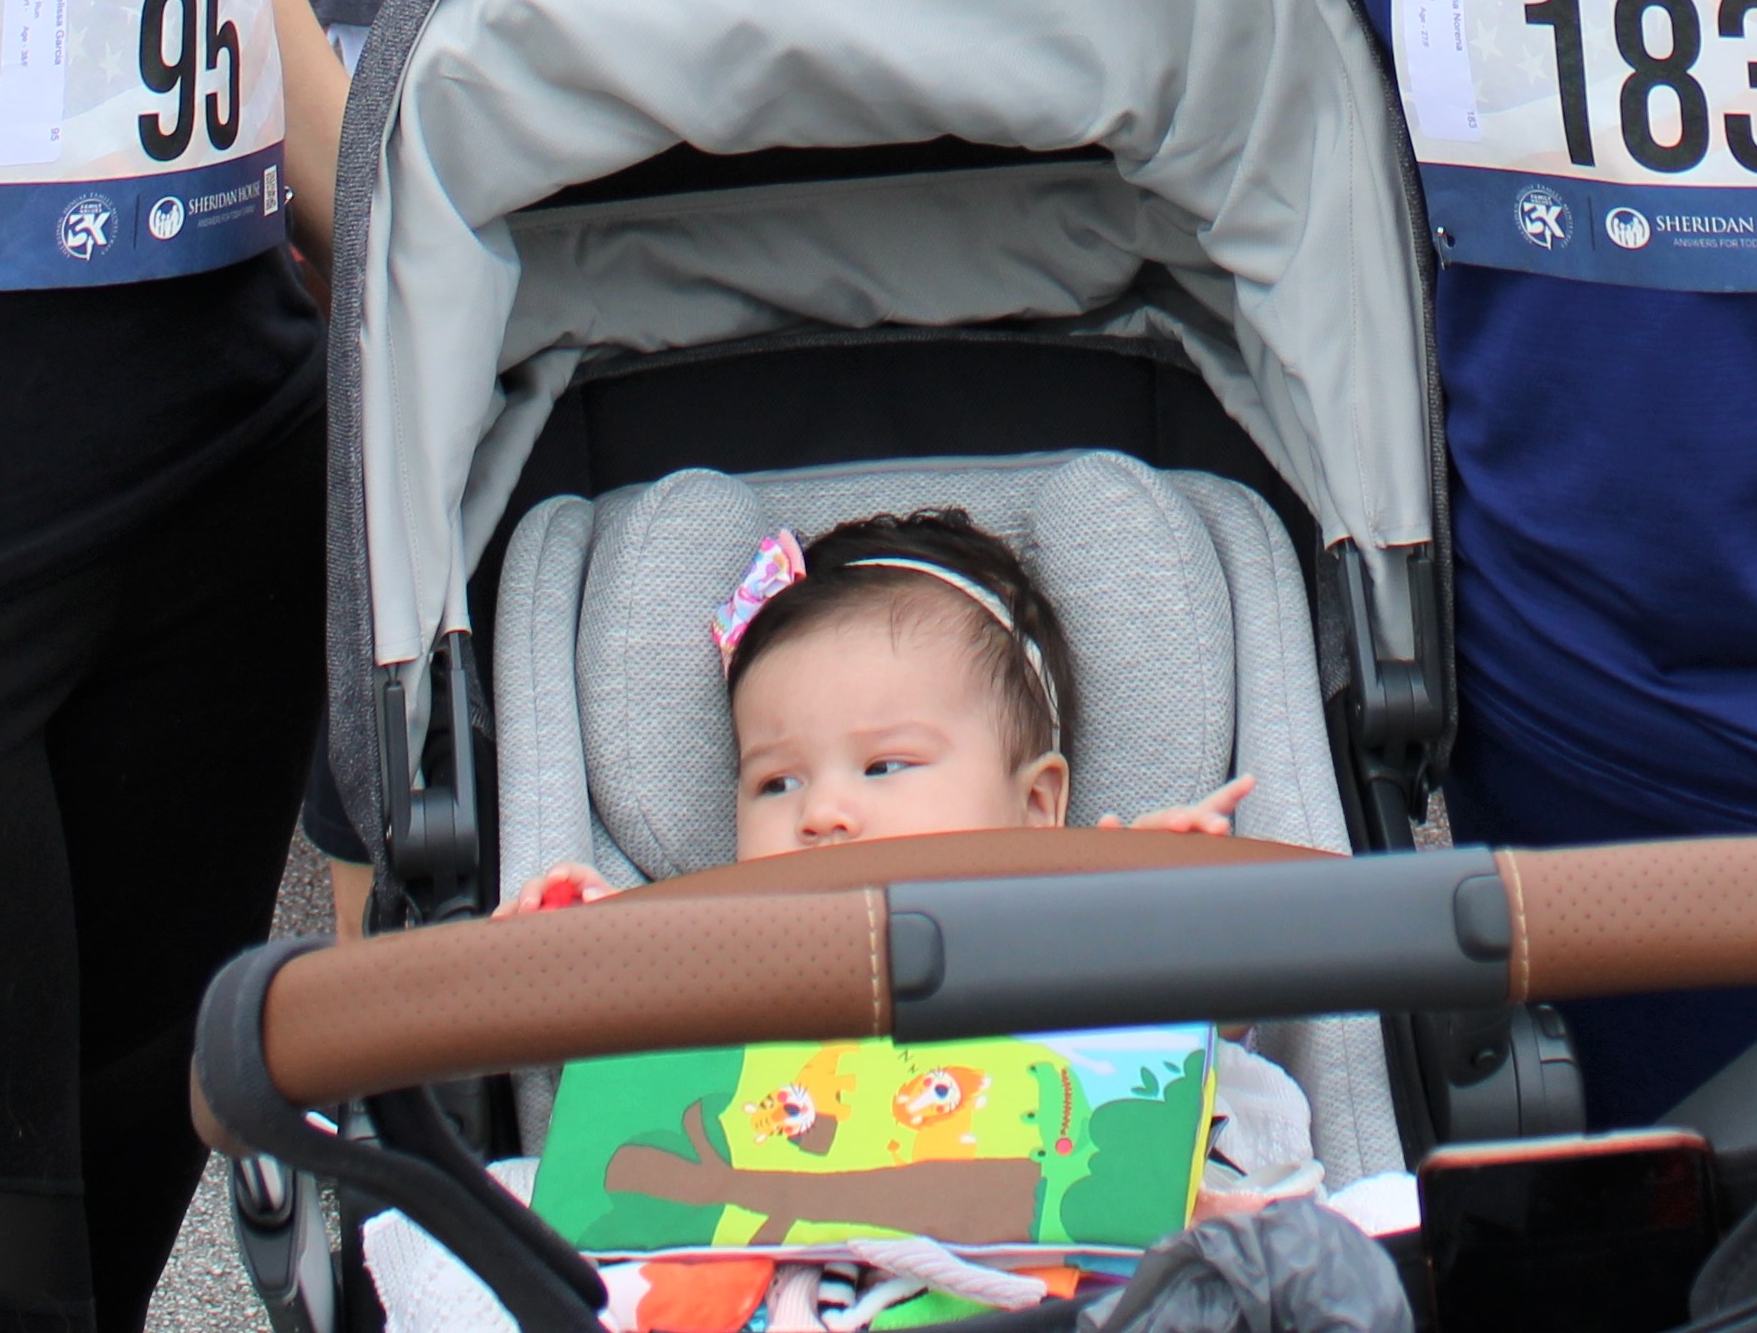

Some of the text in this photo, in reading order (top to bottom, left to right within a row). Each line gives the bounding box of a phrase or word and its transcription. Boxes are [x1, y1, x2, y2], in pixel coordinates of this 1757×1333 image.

[54, 29, 65, 65] Garcia
[1466, 111, 1478, 128] 183
[50, 127, 60, 141] 95
[188, 188, 238, 215] SHERIDAN
[238, 180, 261, 202] HOUSE
[1656, 215, 1754, 233] SHERIDAN
[1673, 237, 1718, 248] ANSWERS
[1719, 238, 1739, 248] FOR
